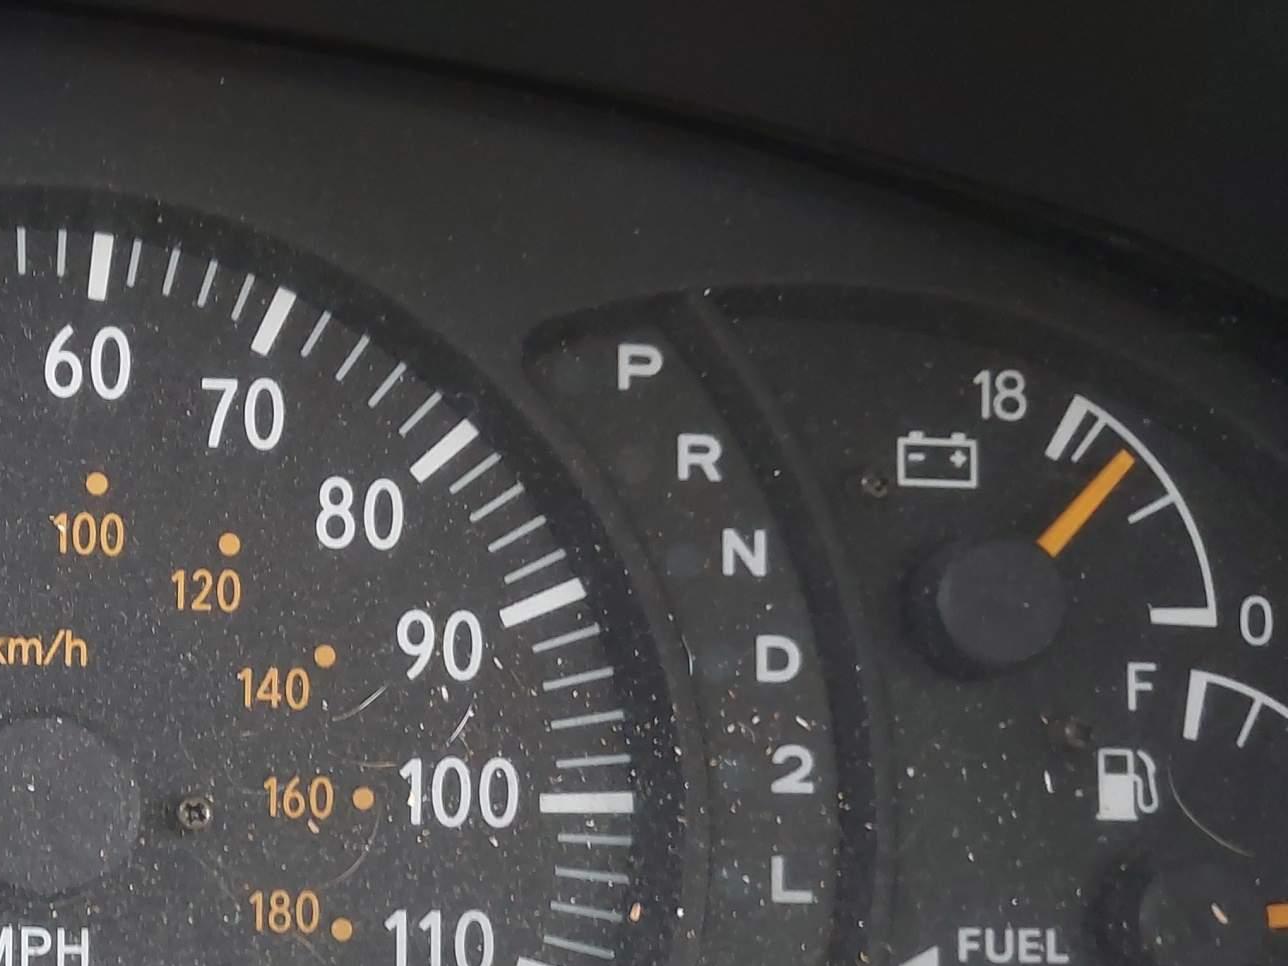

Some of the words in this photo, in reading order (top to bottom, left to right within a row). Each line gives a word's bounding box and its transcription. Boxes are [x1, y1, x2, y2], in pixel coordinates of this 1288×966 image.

[43, 325, 130, 401] 60
[616, 343, 662, 391] P
[200, 377, 285, 451] 70
[973, 370, 1027, 420] 18
[678, 435, 722, 482] R
[55, 512, 125, 556] 100
[314, 476, 405, 550] 80
[723, 529, 766, 577] N
[171, 569, 241, 613] 120
[1240, 595, 1273, 647] 0
[396, 609, 483, 682] 90
[757, 636, 802, 683] D
[237, 668, 310, 711] 140
[1127, 663, 1157, 711] F
[399, 756, 518, 829] 100
[770, 744, 814, 795] 2
[264, 778, 333, 820] 160
[771, 857, 813, 904] L
[249, 891, 319, 935] 180
[958, 927, 1069, 964] FUEL
